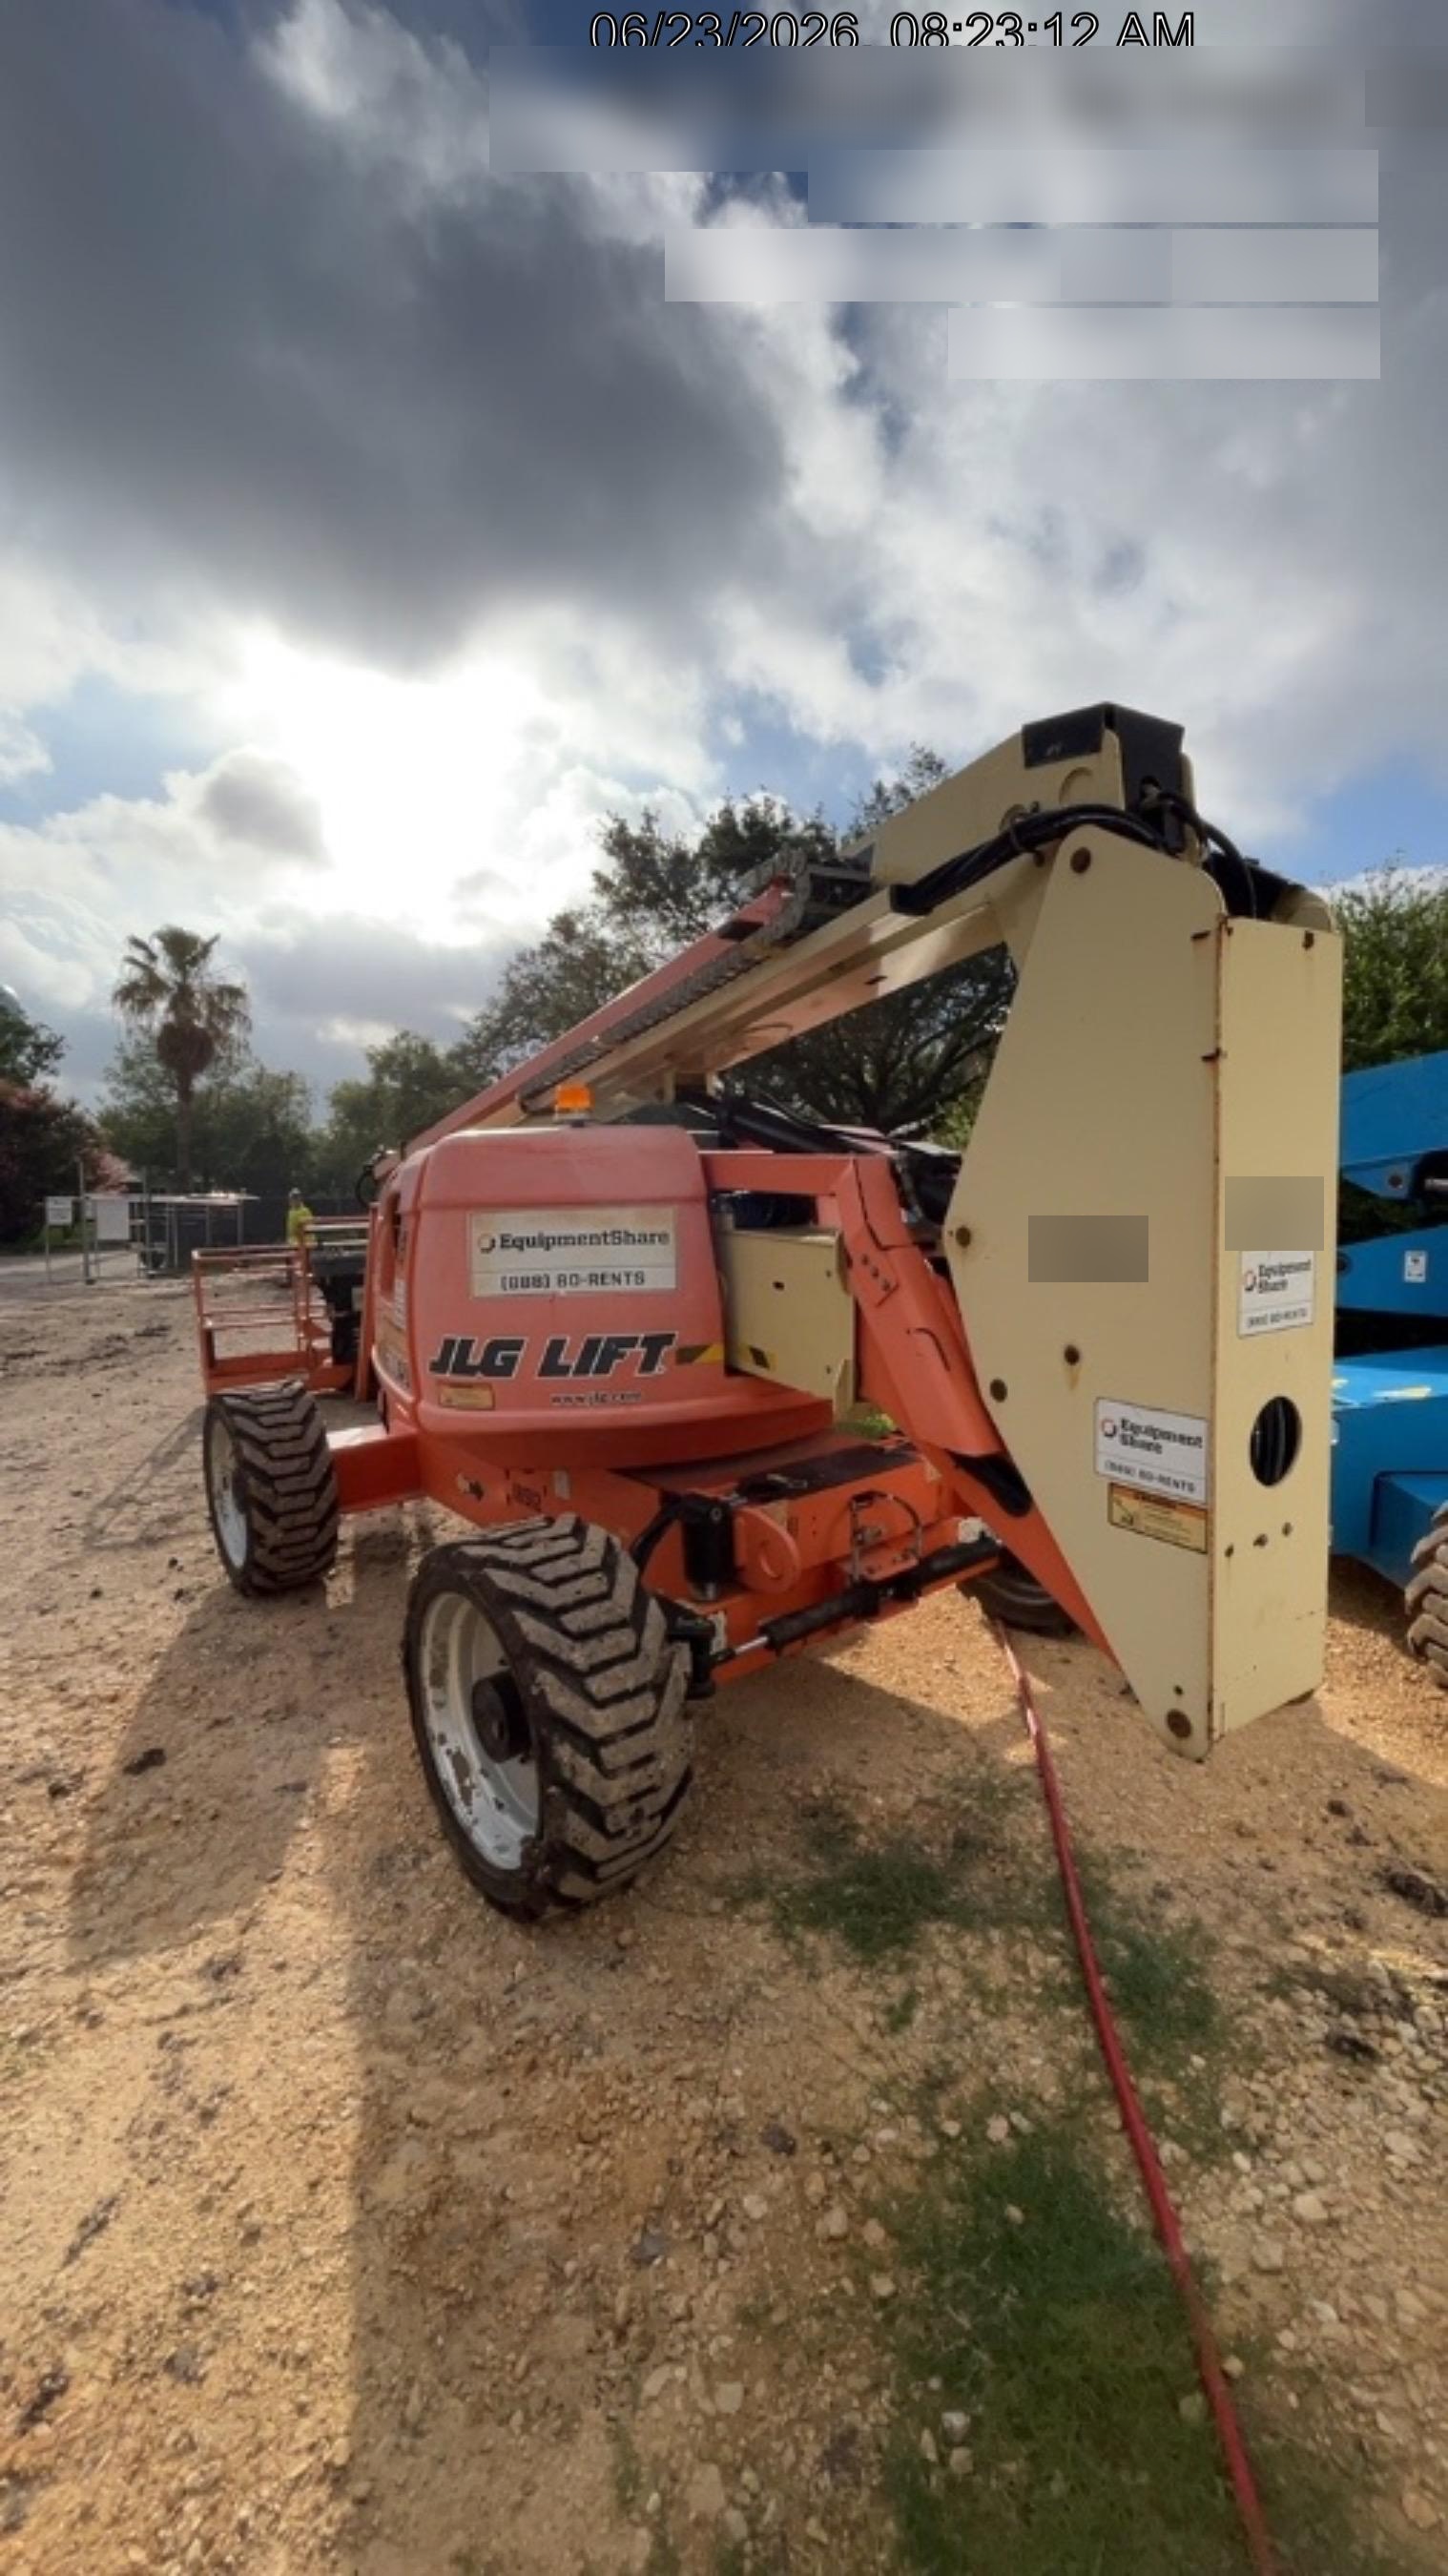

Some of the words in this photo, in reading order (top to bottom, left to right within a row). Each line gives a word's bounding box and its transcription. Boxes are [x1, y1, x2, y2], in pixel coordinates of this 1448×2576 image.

[499, 1229, 671, 1252] EquipmentShare
[428, 1336, 527, 1379] JLG
[535, 1330, 679, 1379] LIFT
